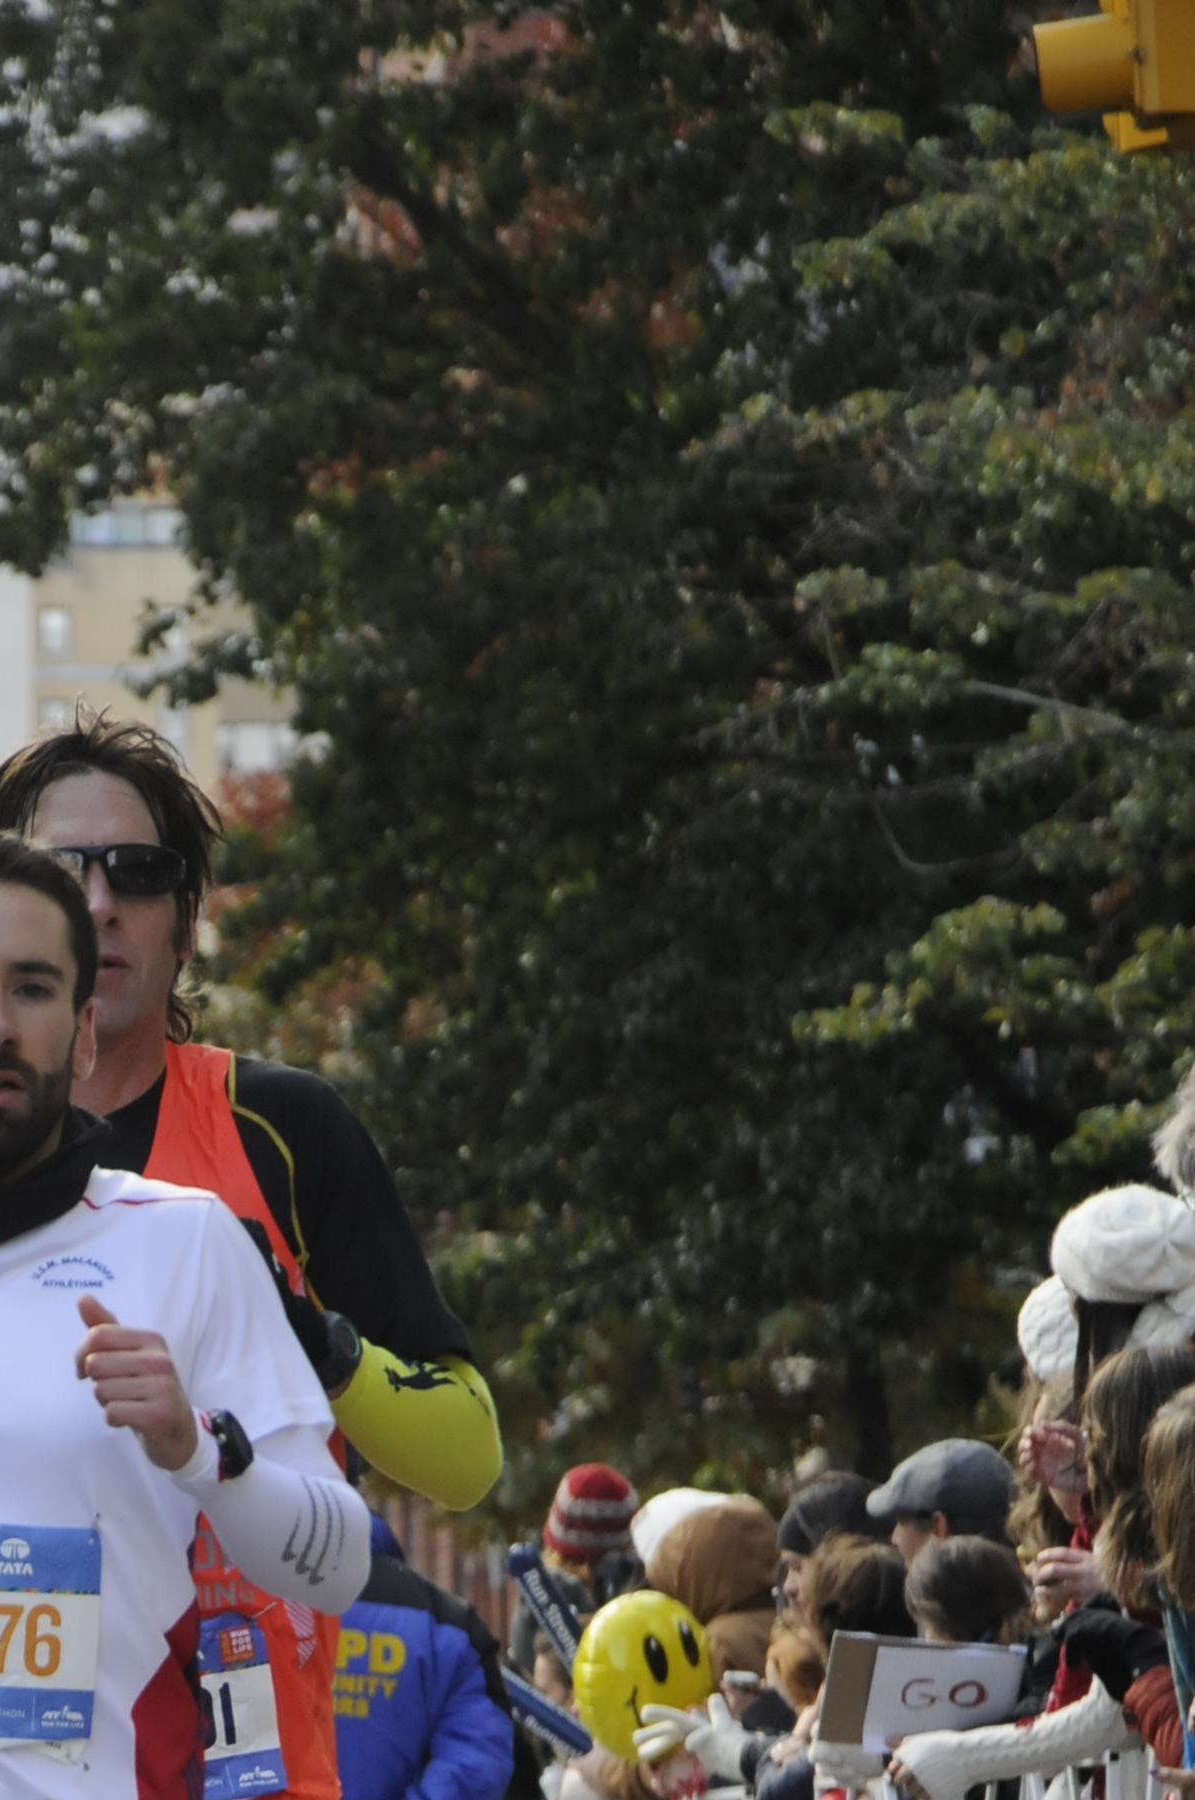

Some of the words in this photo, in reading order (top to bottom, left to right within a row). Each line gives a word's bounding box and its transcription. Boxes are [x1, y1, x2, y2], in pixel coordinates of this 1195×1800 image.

[523, 1568, 549, 1606] Run
[336, 1629, 406, 1674] PD
[901, 1677, 988, 1711] GO
